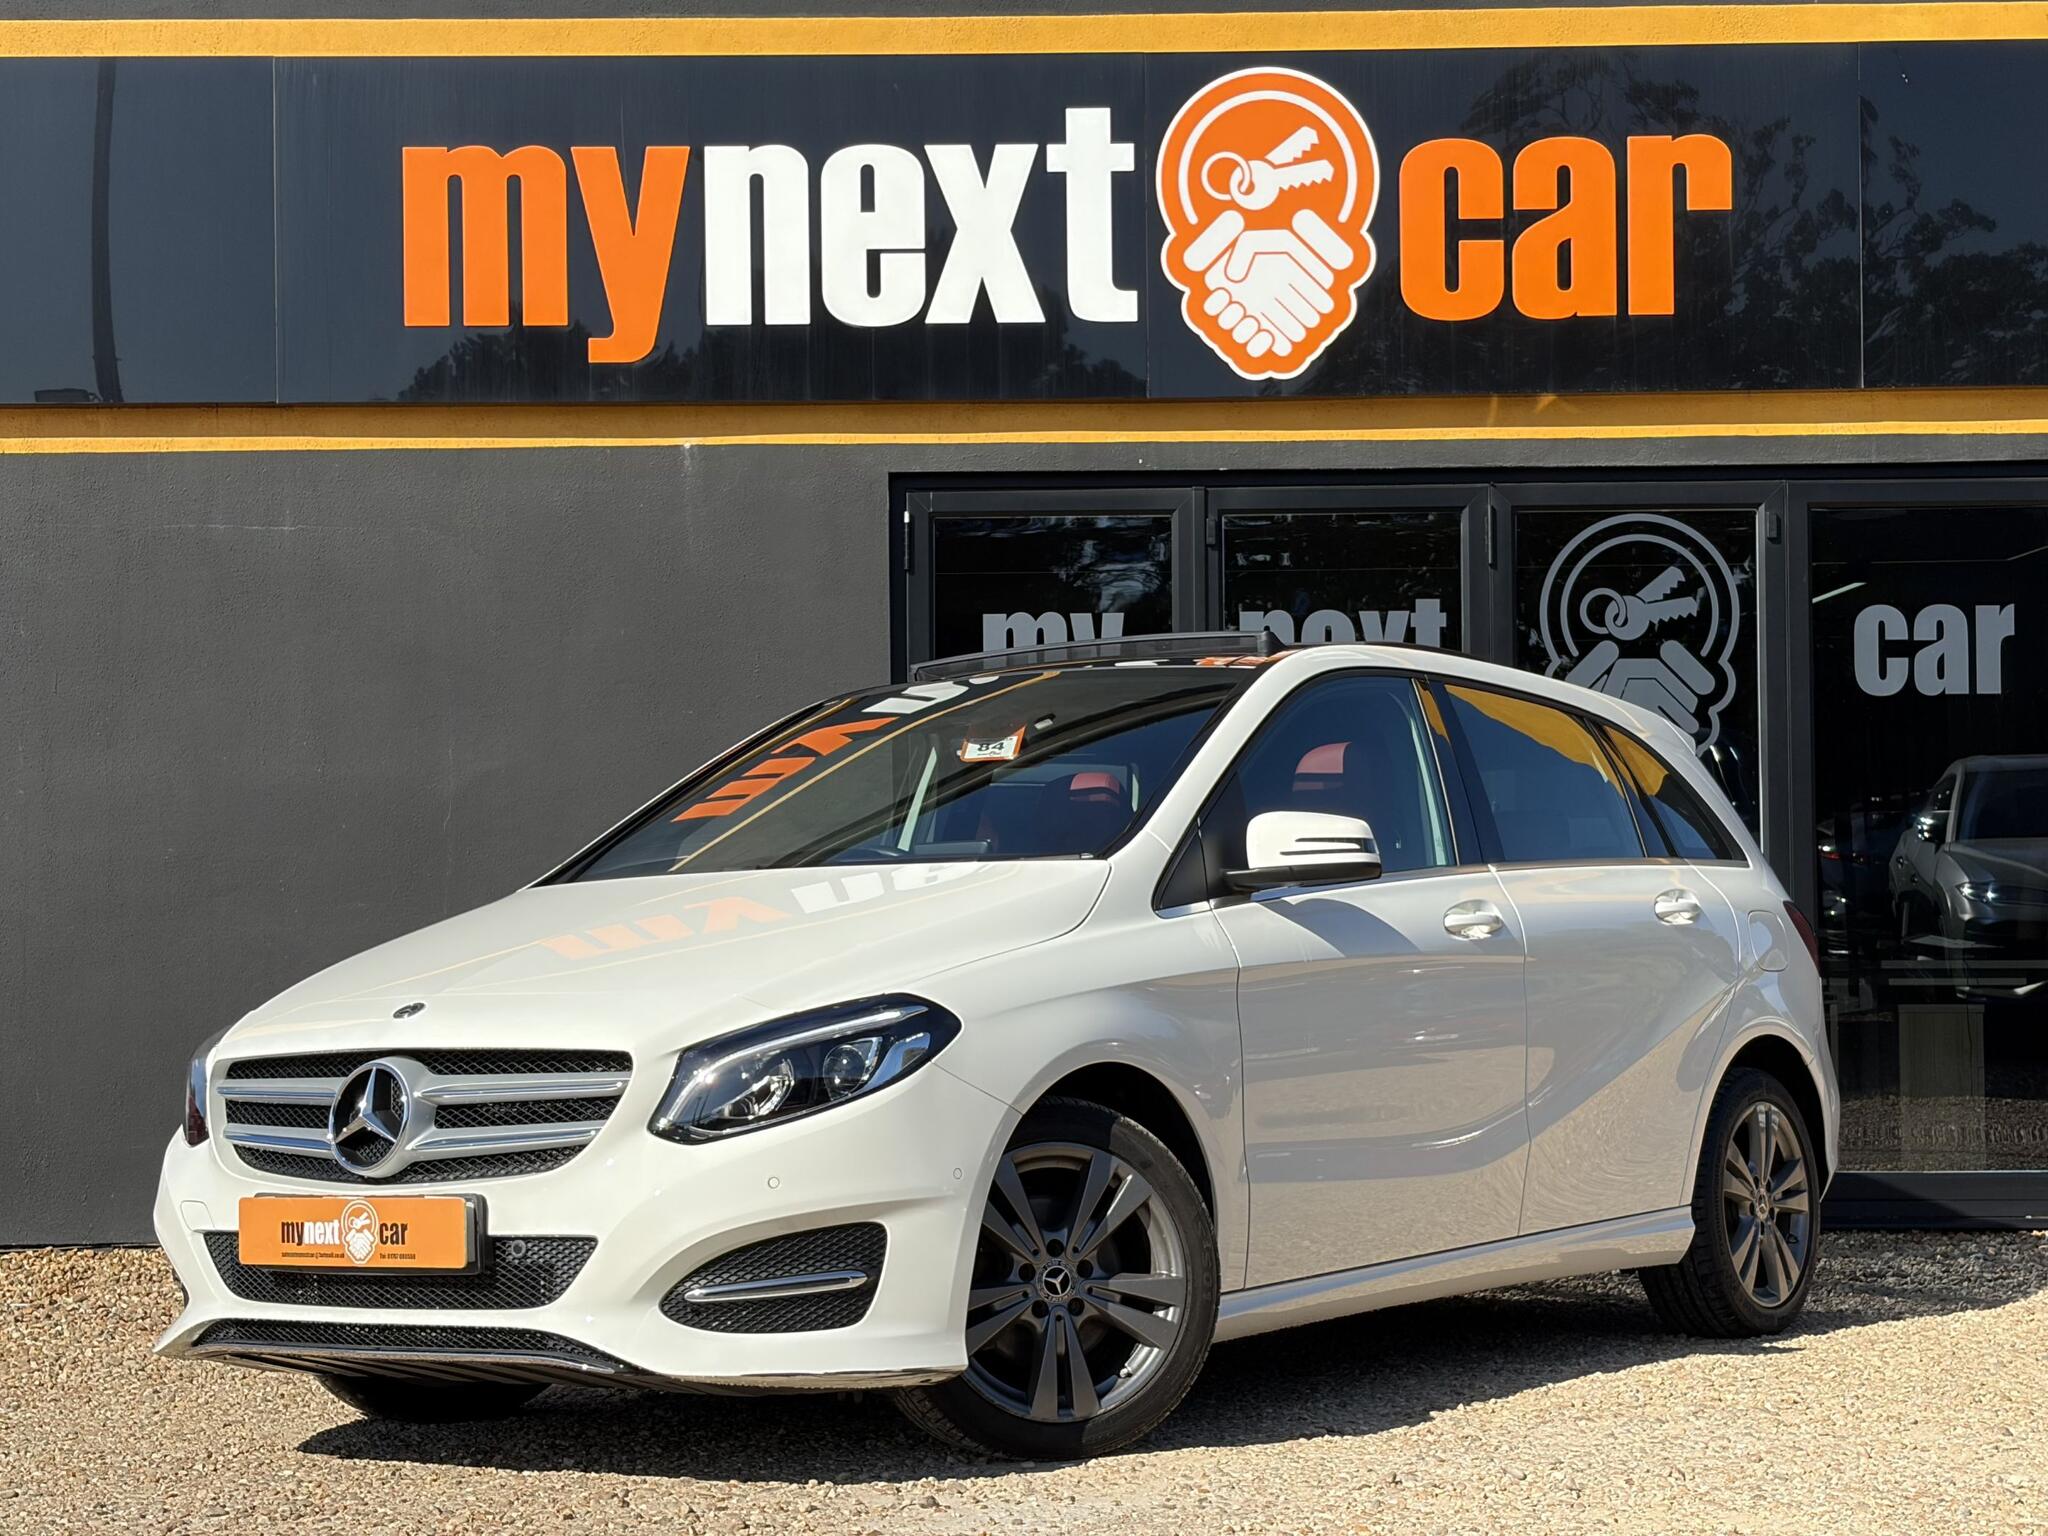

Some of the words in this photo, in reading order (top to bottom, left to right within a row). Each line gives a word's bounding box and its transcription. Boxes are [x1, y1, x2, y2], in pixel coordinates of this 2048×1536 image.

[1398, 133, 1734, 322] car
[1854, 603, 2015, 697] car
[379, 1222, 408, 1245] car
